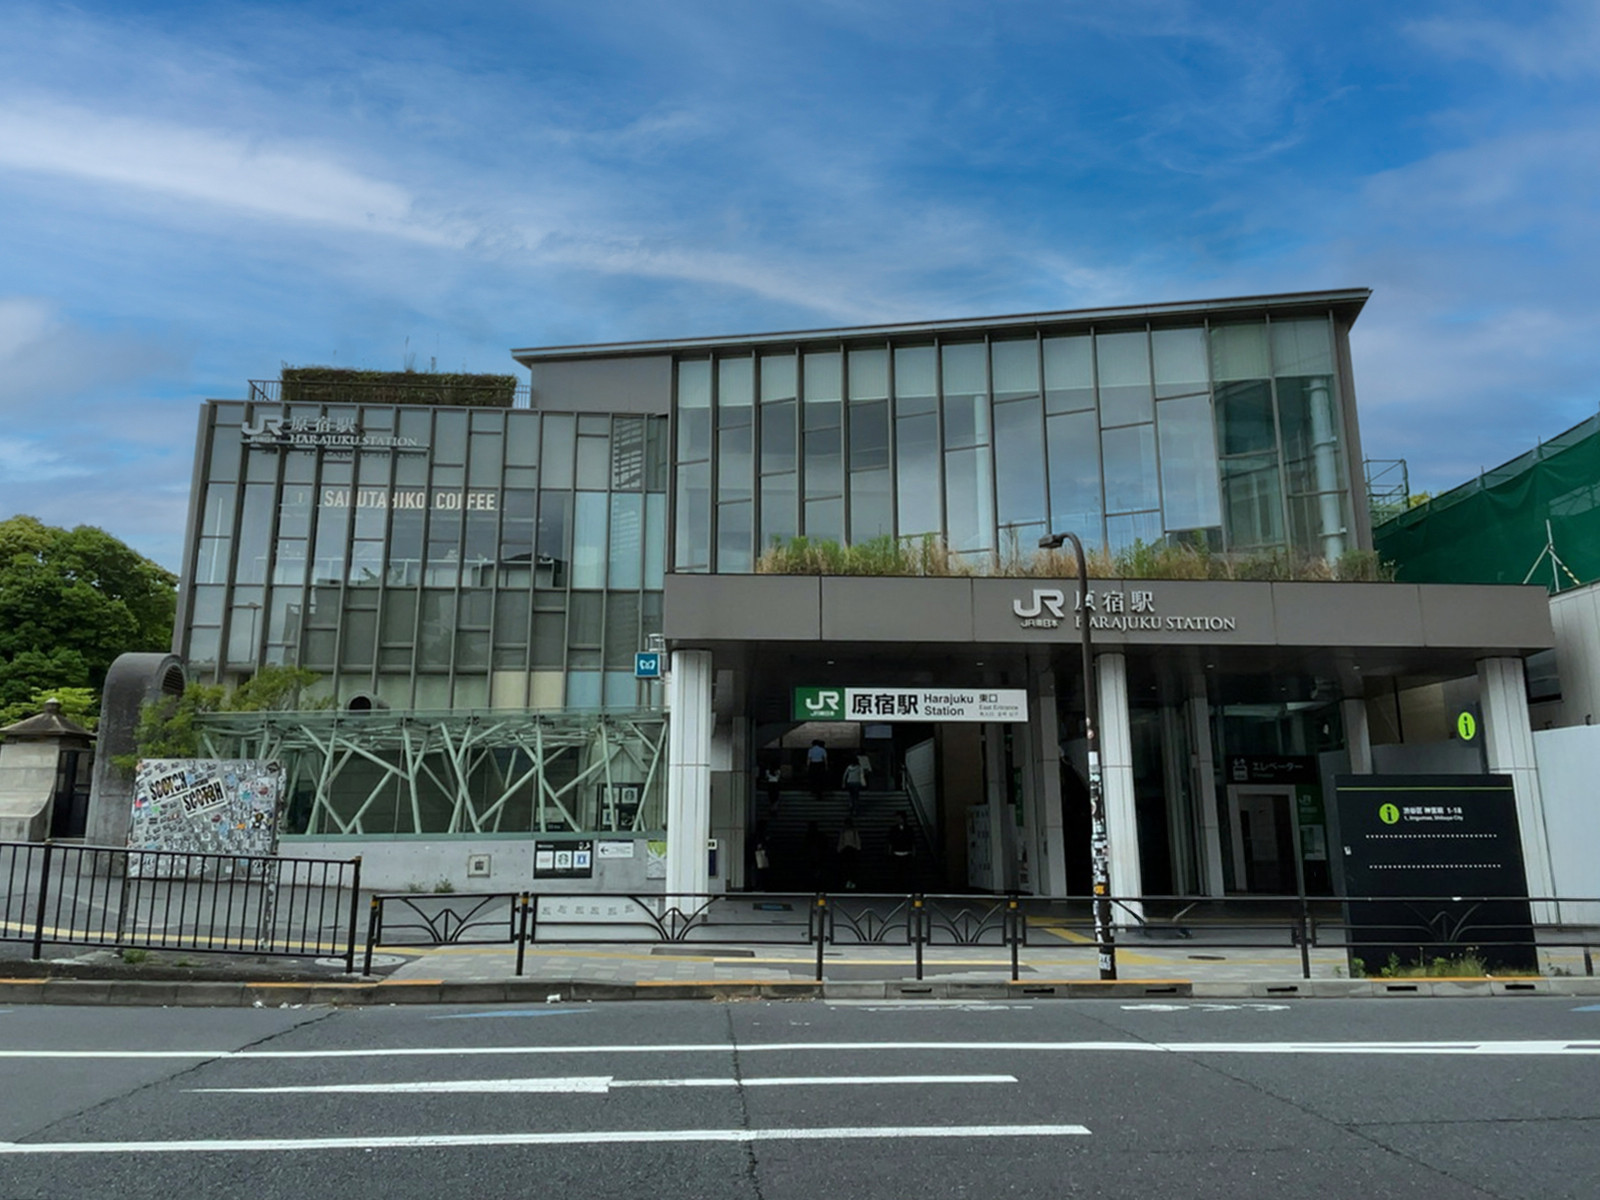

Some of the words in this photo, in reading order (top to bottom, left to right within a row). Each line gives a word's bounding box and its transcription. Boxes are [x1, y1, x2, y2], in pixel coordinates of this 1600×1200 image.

[242, 414, 284, 435] JR
[290, 415, 358, 433] 原宿駅
[290, 434, 360, 446] HARAJUKU
[362, 436, 418, 447] STATION
[1013, 588, 1065, 618] JR
[1165, 616, 1236, 630] STATION
[805, 691, 840, 710] JR
[851, 693, 919, 716] 原宿駅
[923, 693, 974, 705] Harajuku
[924, 705, 965, 716] Station
